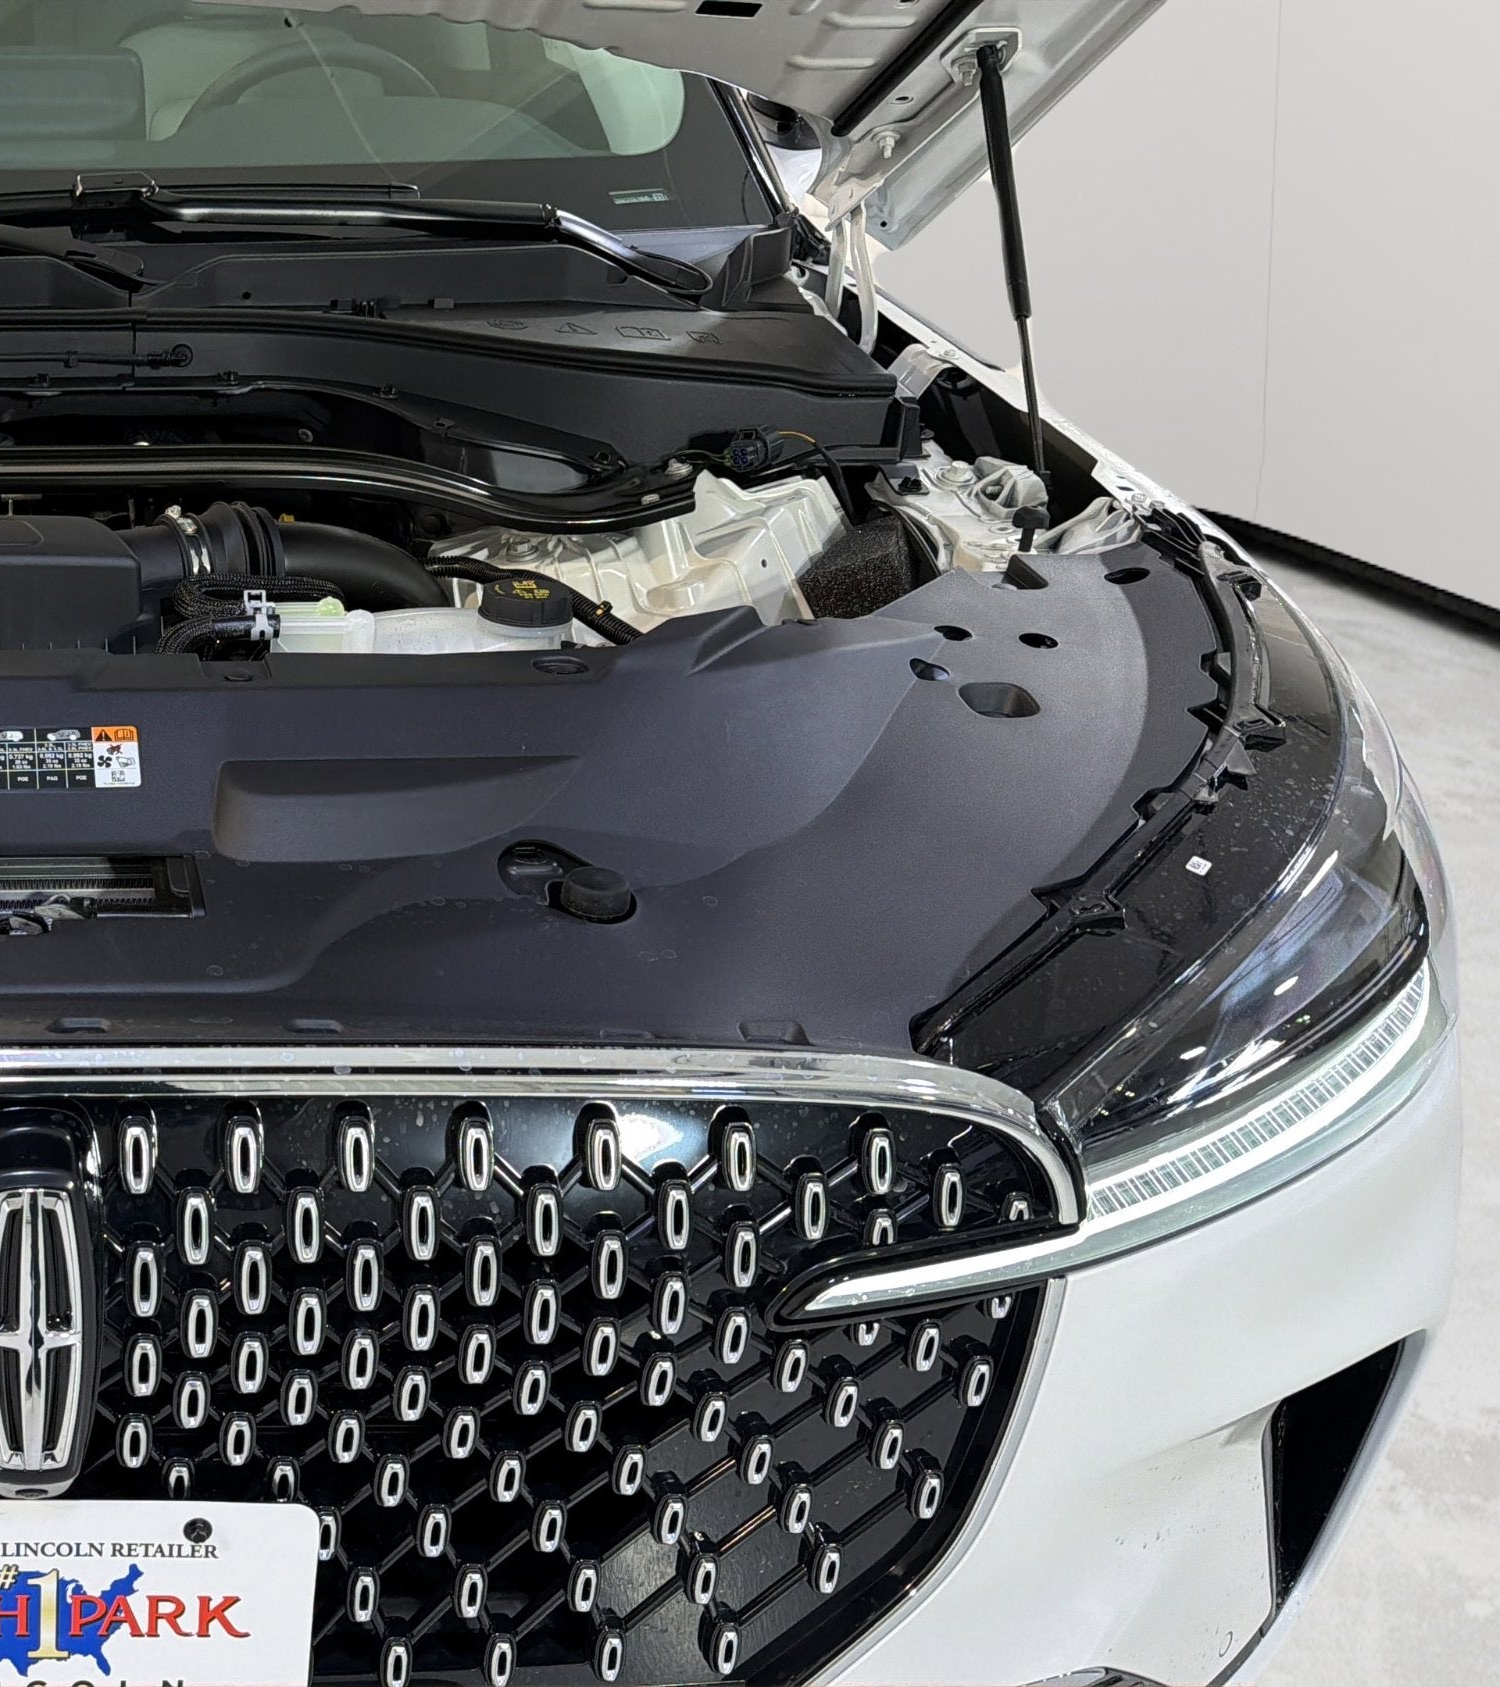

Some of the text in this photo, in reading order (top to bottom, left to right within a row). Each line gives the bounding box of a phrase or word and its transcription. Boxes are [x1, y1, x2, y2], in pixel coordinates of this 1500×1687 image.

[1, 1542, 105, 1558] LINCOLN
[110, 1542, 219, 1559] RETAILER
[68, 1594, 252, 1639] PARK
